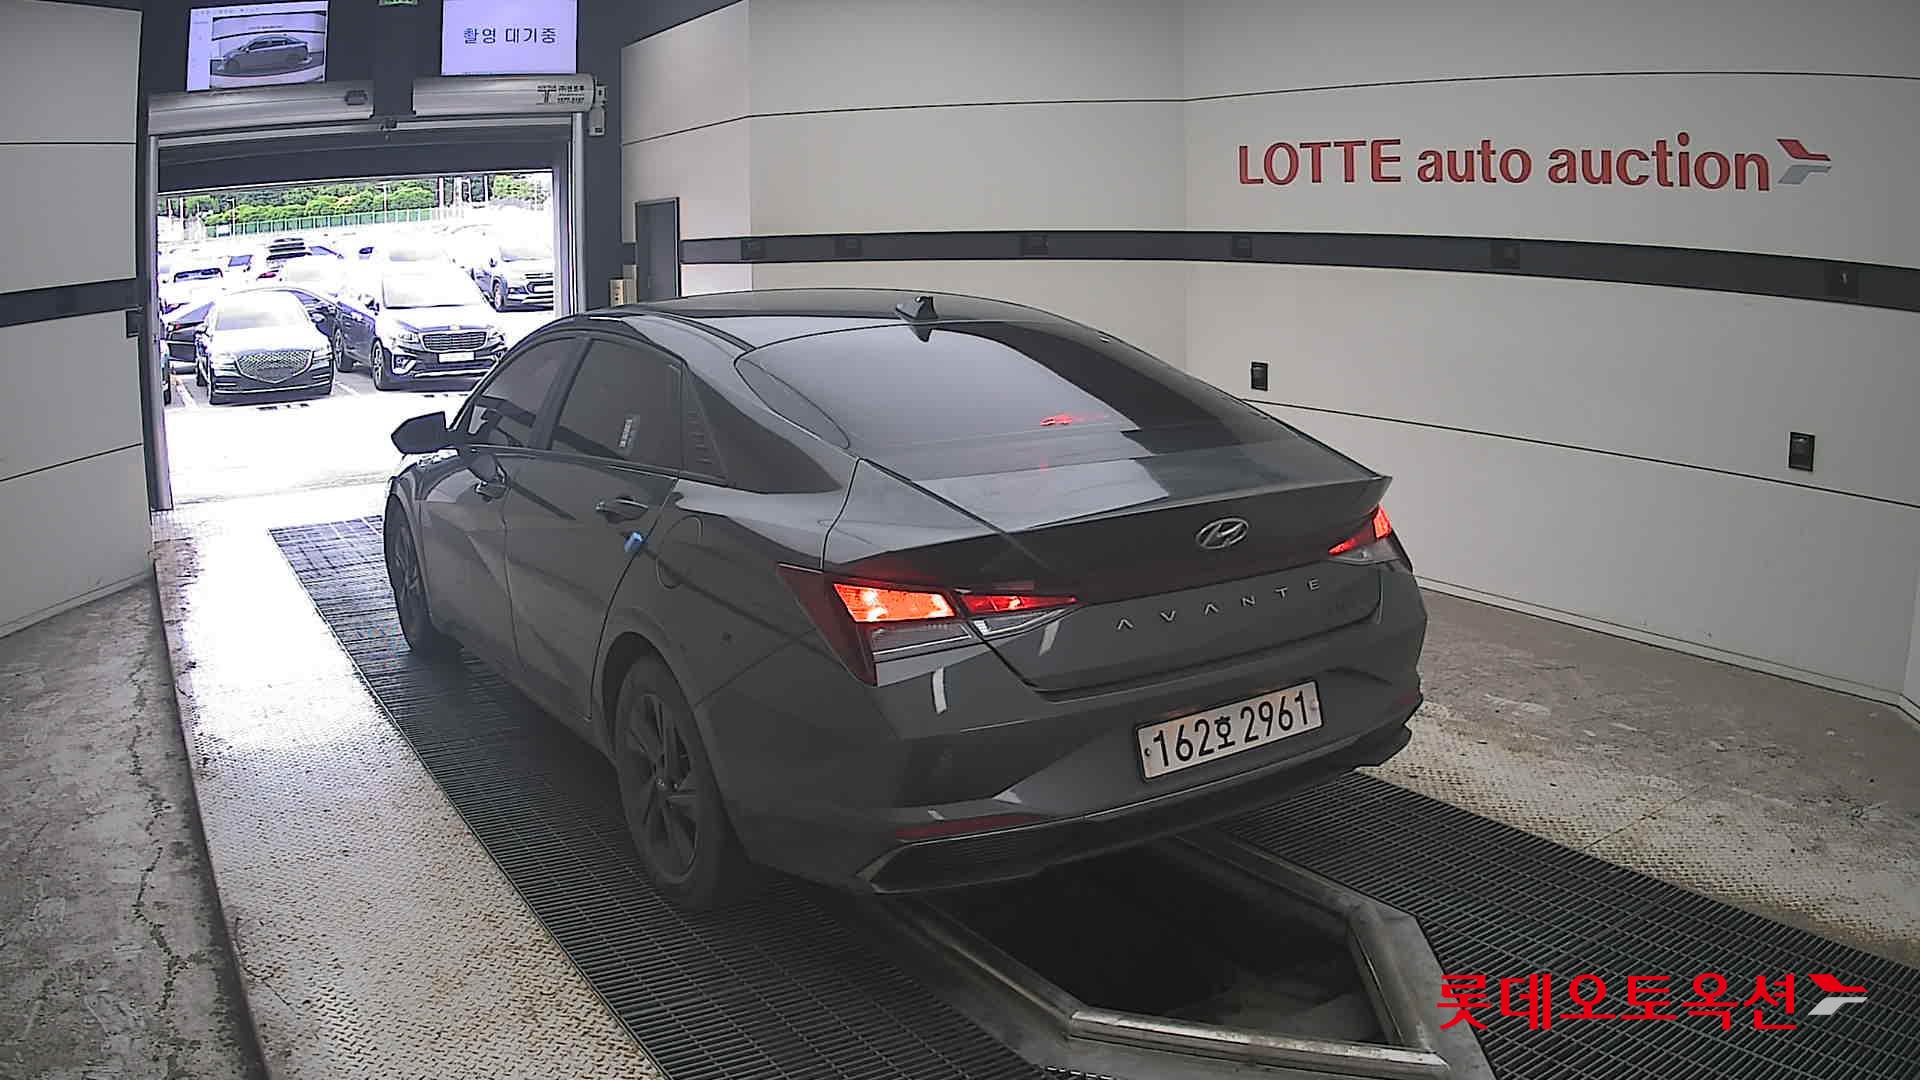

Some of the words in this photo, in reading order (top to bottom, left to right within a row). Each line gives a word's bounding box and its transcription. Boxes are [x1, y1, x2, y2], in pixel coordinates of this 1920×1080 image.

[464, 27, 496, 44] 촬영
[505, 27, 557, 44] 대기중
[1239, 139, 1402, 185] LOTTE
[1417, 139, 1532, 184] auto
[1548, 132, 1771, 191] auction
[1116, 578, 1321, 631] AVANTE
[1153, 715, 1235, 767] 162호
[1240, 690, 1309, 744] 2961
